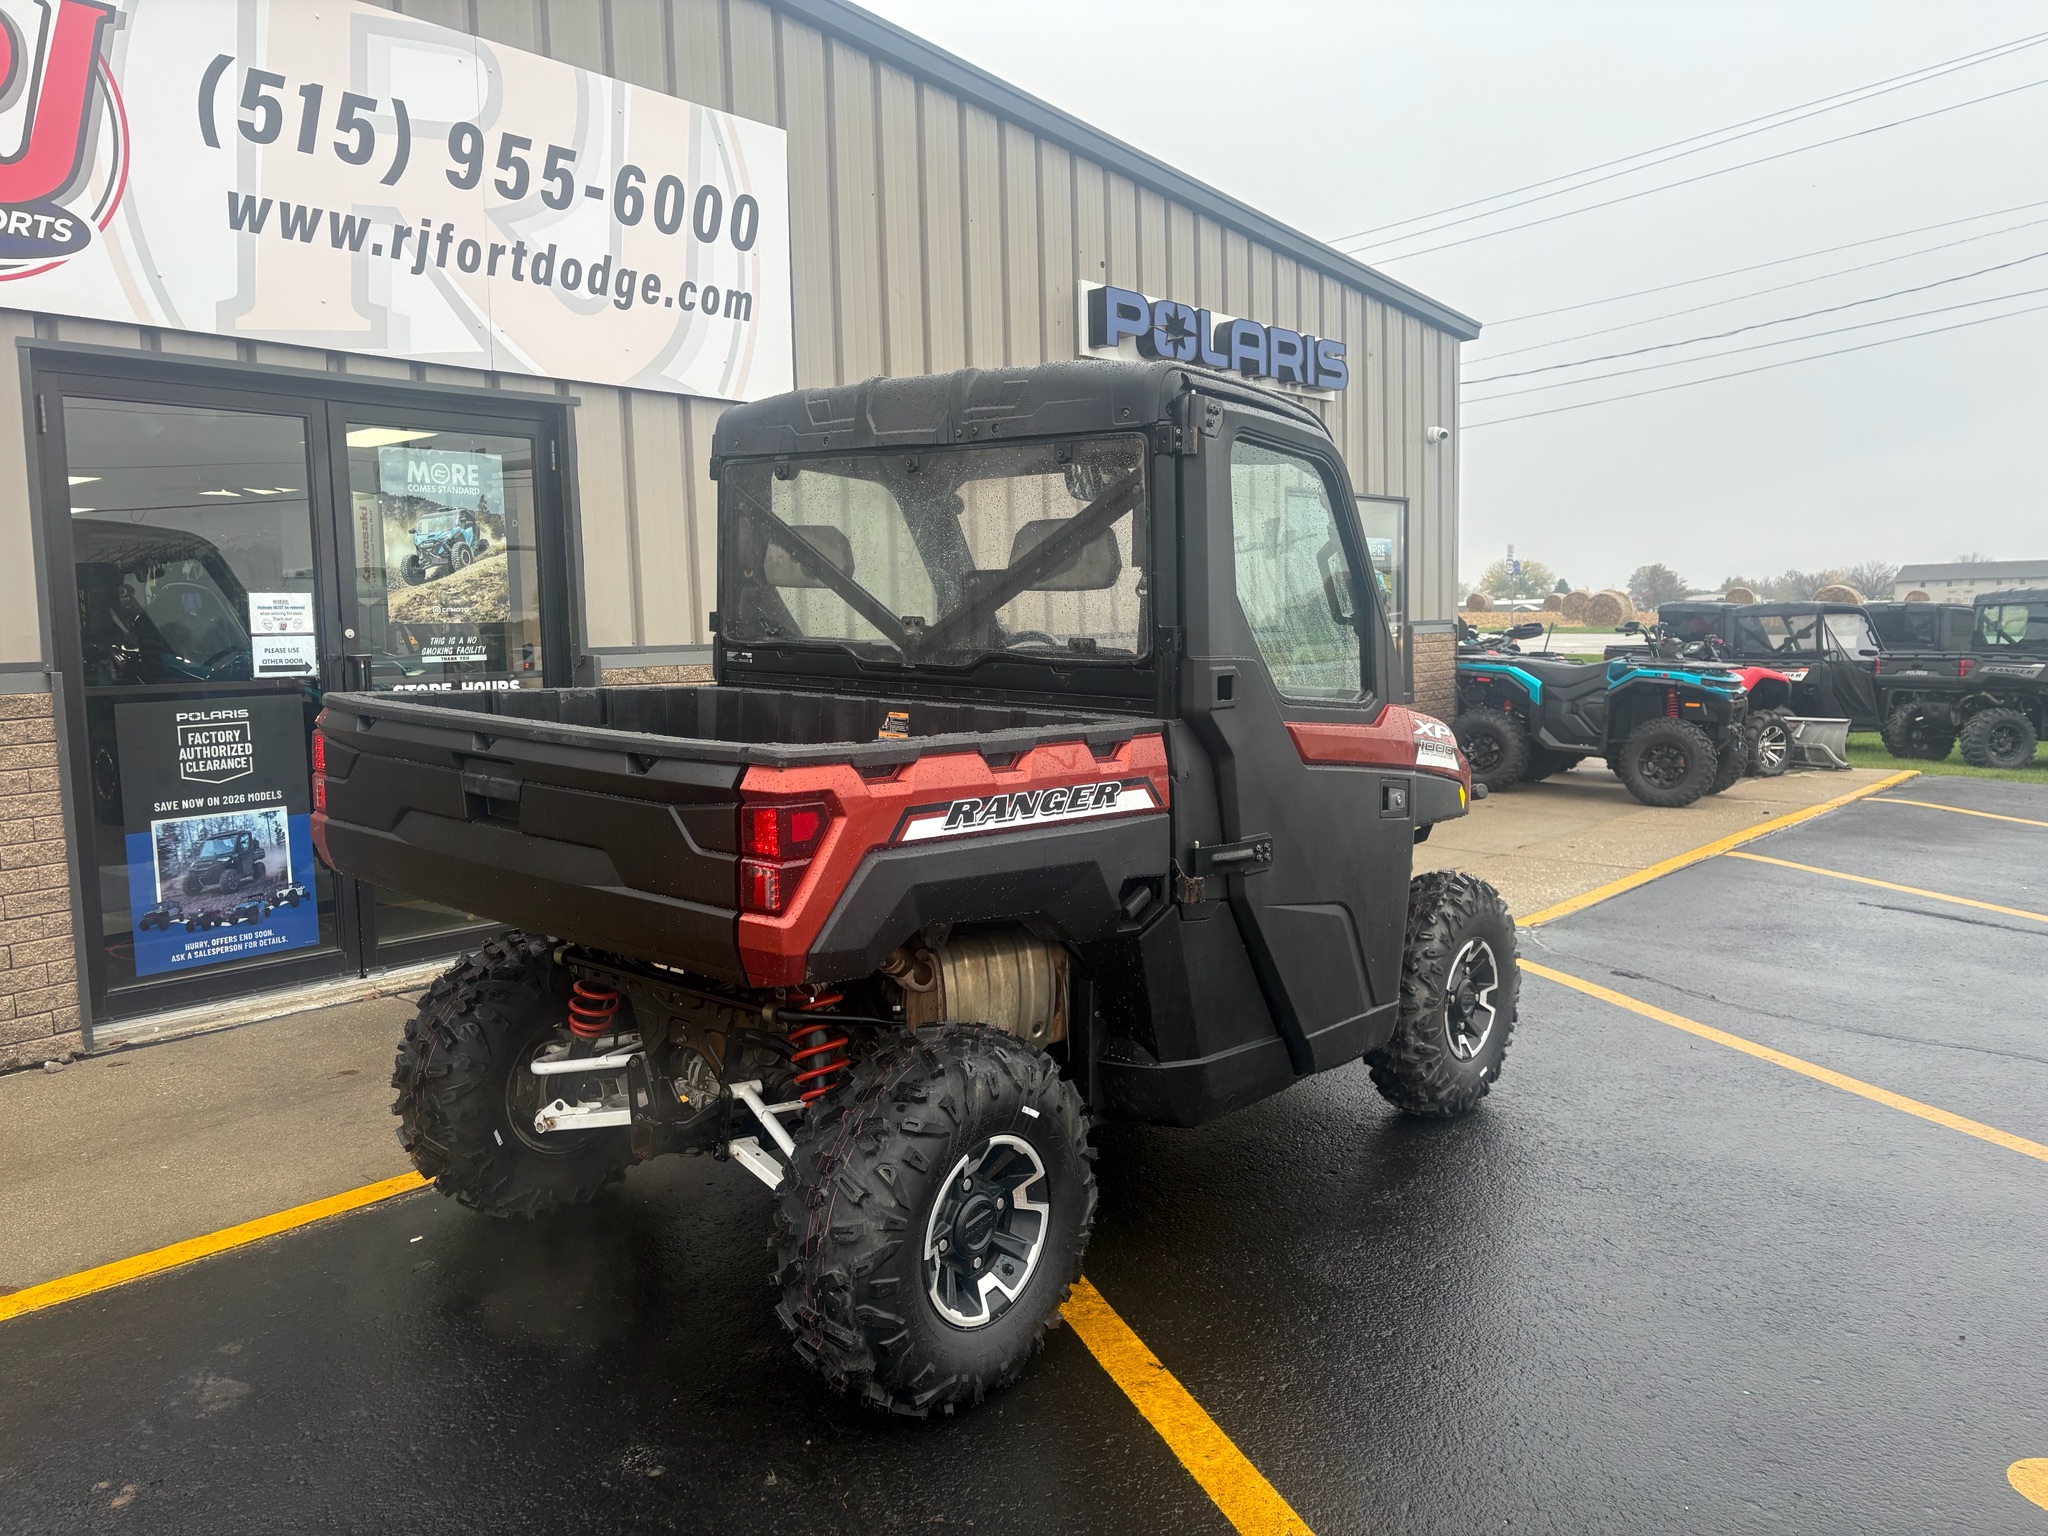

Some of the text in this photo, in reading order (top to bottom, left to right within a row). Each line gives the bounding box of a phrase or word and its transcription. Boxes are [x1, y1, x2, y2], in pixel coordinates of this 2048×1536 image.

[198, 53, 760, 252] (515) 955-6000
[227, 190, 753, 322] www.rjfortdodge.com
[1089, 285, 1349, 391] POLARIS
[407, 460, 480, 486] MORE
[407, 484, 480, 495] COMES STANDARD
[359, 505, 371, 584] Kawasaki
[430, 636, 478, 645] THIS IS A NO
[422, 646, 487, 656] SMOKING FACILITY
[1987, 667, 2036, 676] RANGER
[176, 709, 249, 722] POLARIS
[187, 729, 241, 745] FACTORY
[1413, 719, 1451, 739] XP
[179, 742, 253, 760] AUTHORIZED
[1420, 740, 1454, 756] 1000
[186, 757, 248, 773] CLEARANCE
[154, 790, 282, 812] SAVE NOW ON 2026 MODELS
[941, 780, 1123, 831] RANGER
[171, 936, 289, 963] ASK A SALESPERSON FOR DETAILS.
[184, 930, 274, 951] HURRY, OFFERS END SOON.
